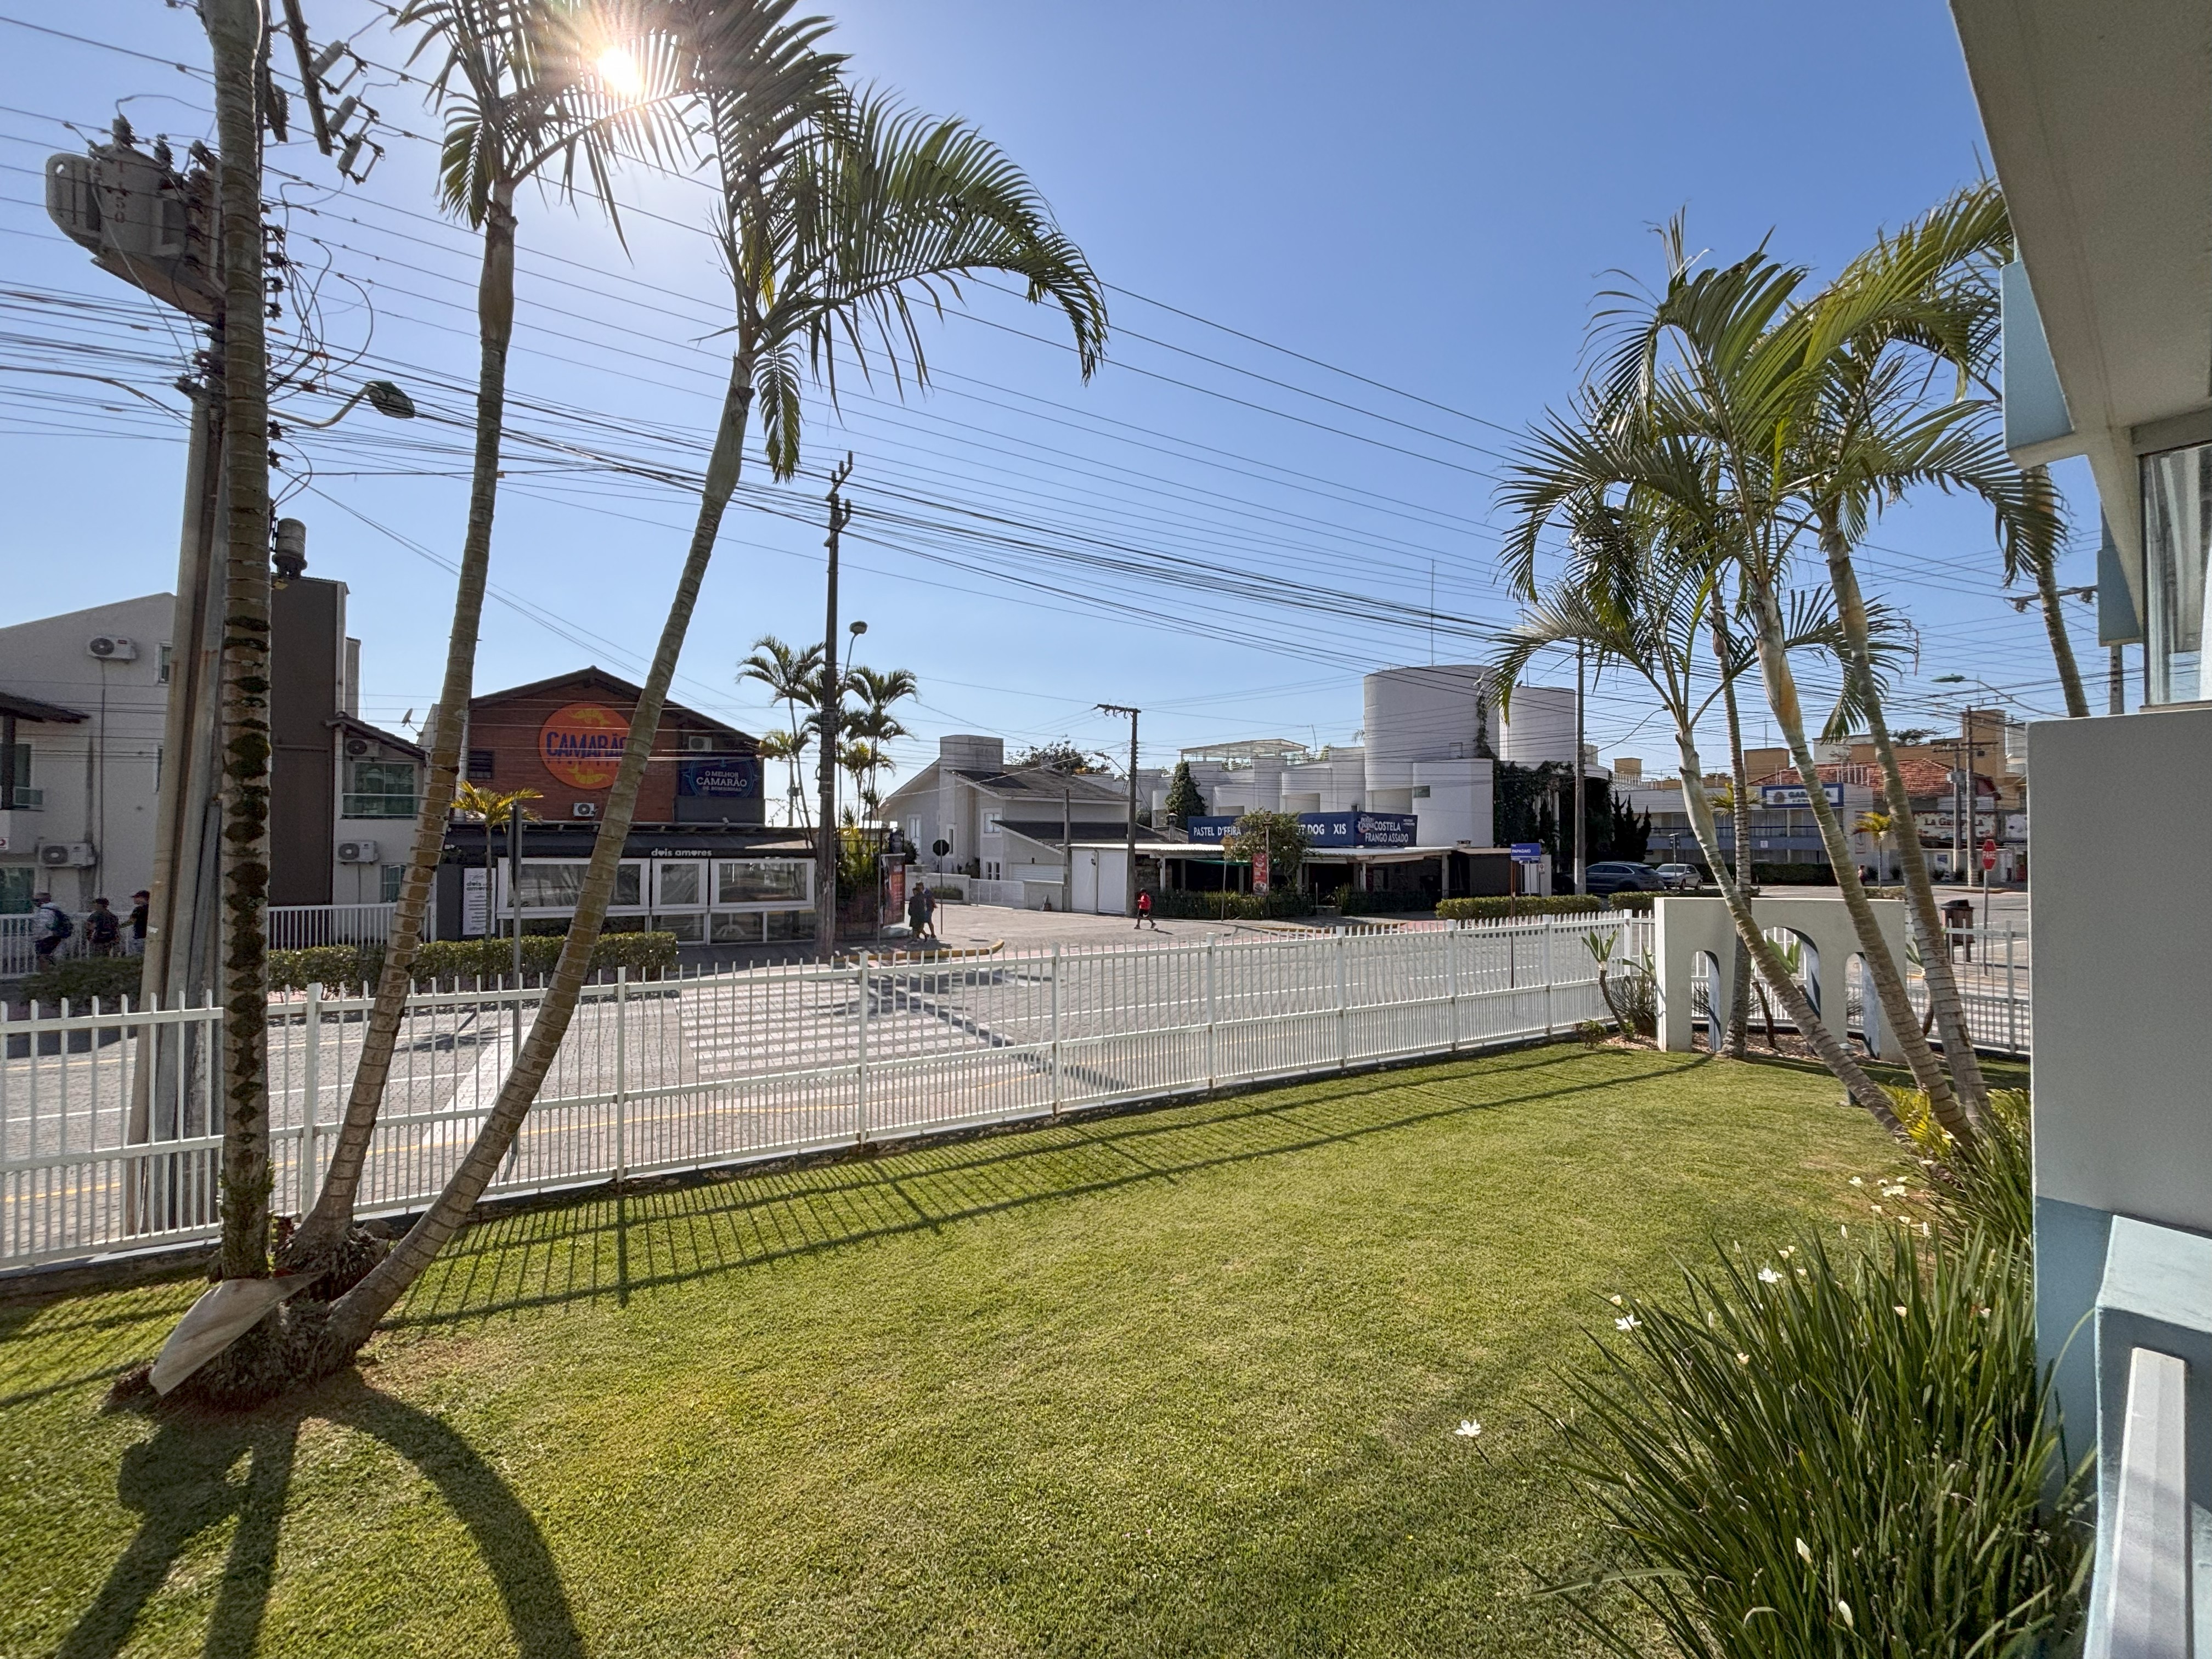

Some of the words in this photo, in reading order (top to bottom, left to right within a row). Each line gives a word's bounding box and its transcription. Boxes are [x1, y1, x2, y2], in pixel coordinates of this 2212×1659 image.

[696, 776, 747, 787] CAMARÃO
[1193, 826, 1215, 836] PASTEL
[1307, 823, 1325, 834] DOG
[1333, 823, 1346, 834] XIS
[1374, 821, 1401, 831] COSTELA
[1365, 832, 1387, 842] FRANGO
[1388, 833, 1408, 843] ASSADO
[1983, 851, 1996, 859] PARE
